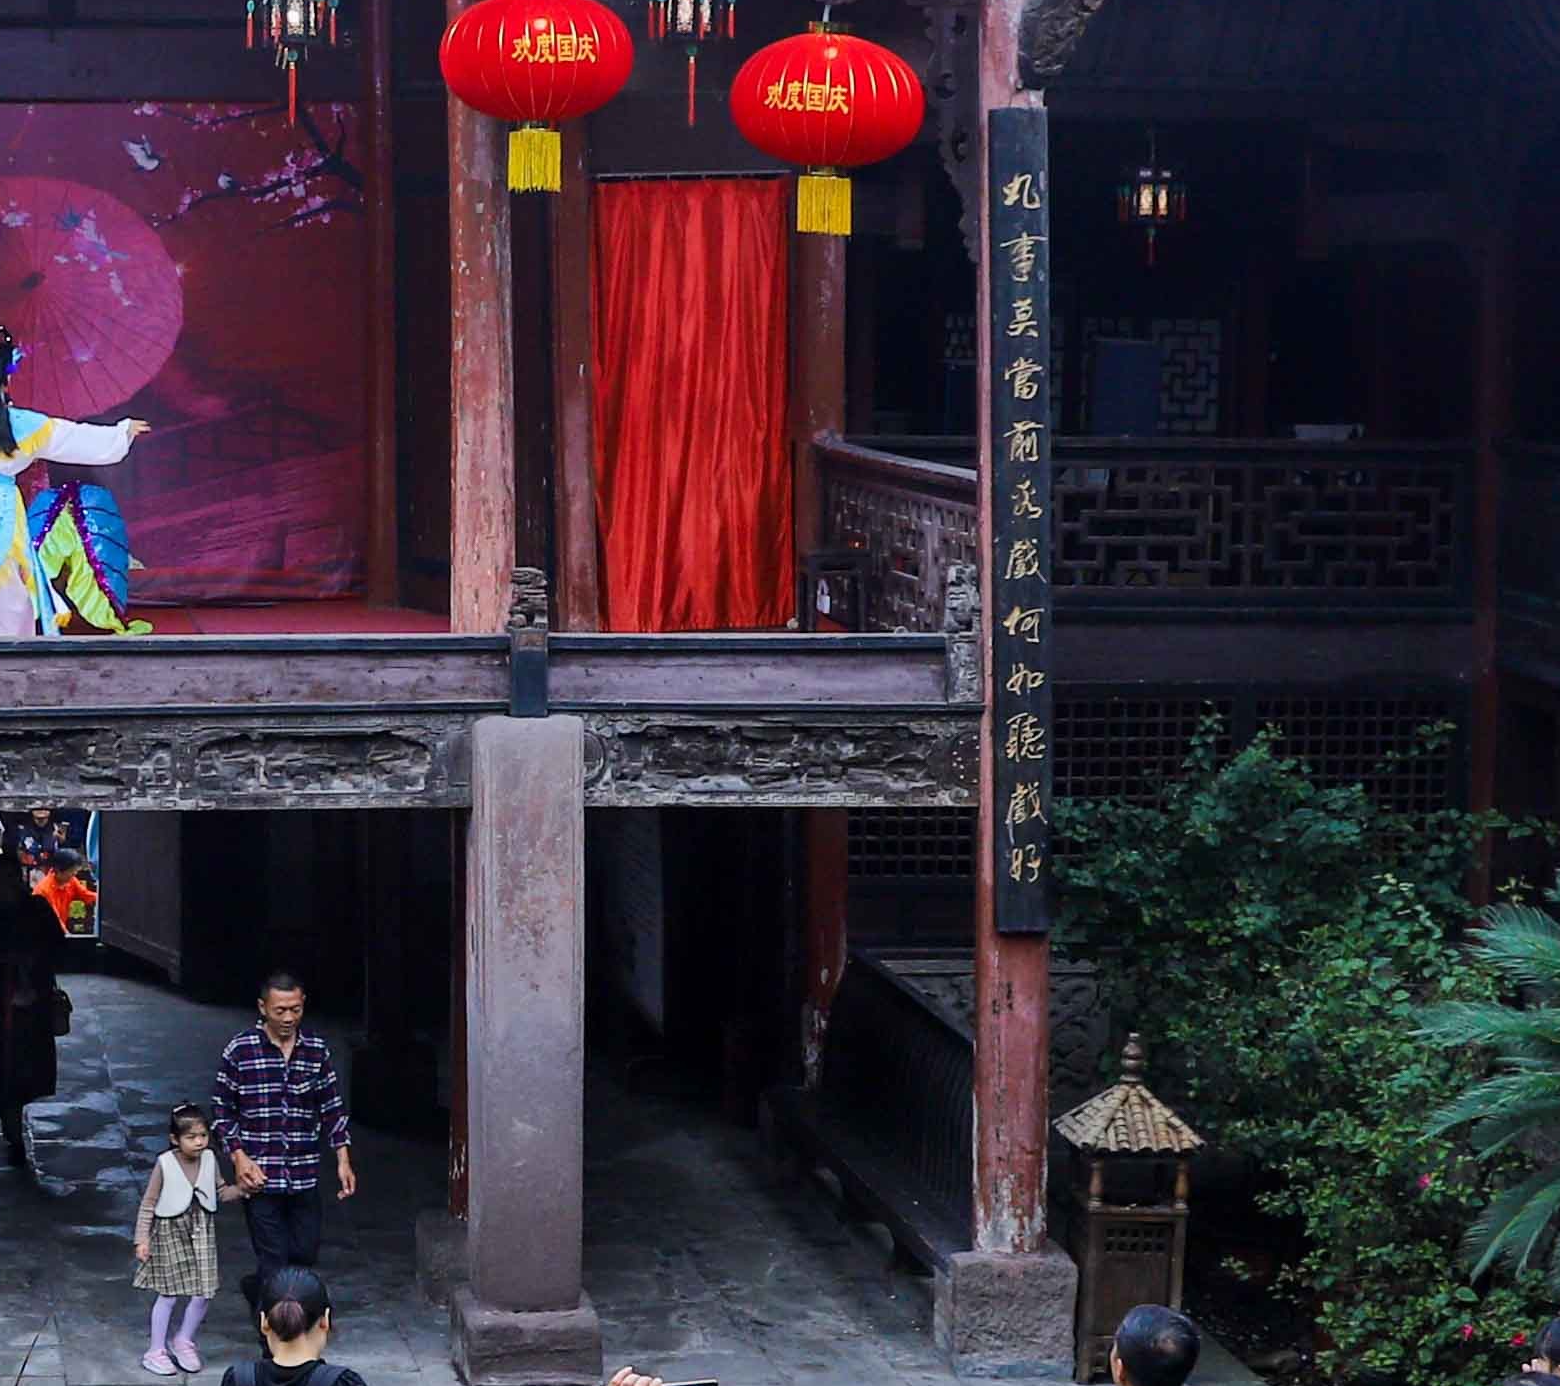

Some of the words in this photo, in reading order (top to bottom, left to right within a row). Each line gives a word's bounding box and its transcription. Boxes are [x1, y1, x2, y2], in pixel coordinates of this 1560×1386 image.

[512, 33, 597, 63] 欢度国庆
[764, 80, 849, 115] 欢度国庆
